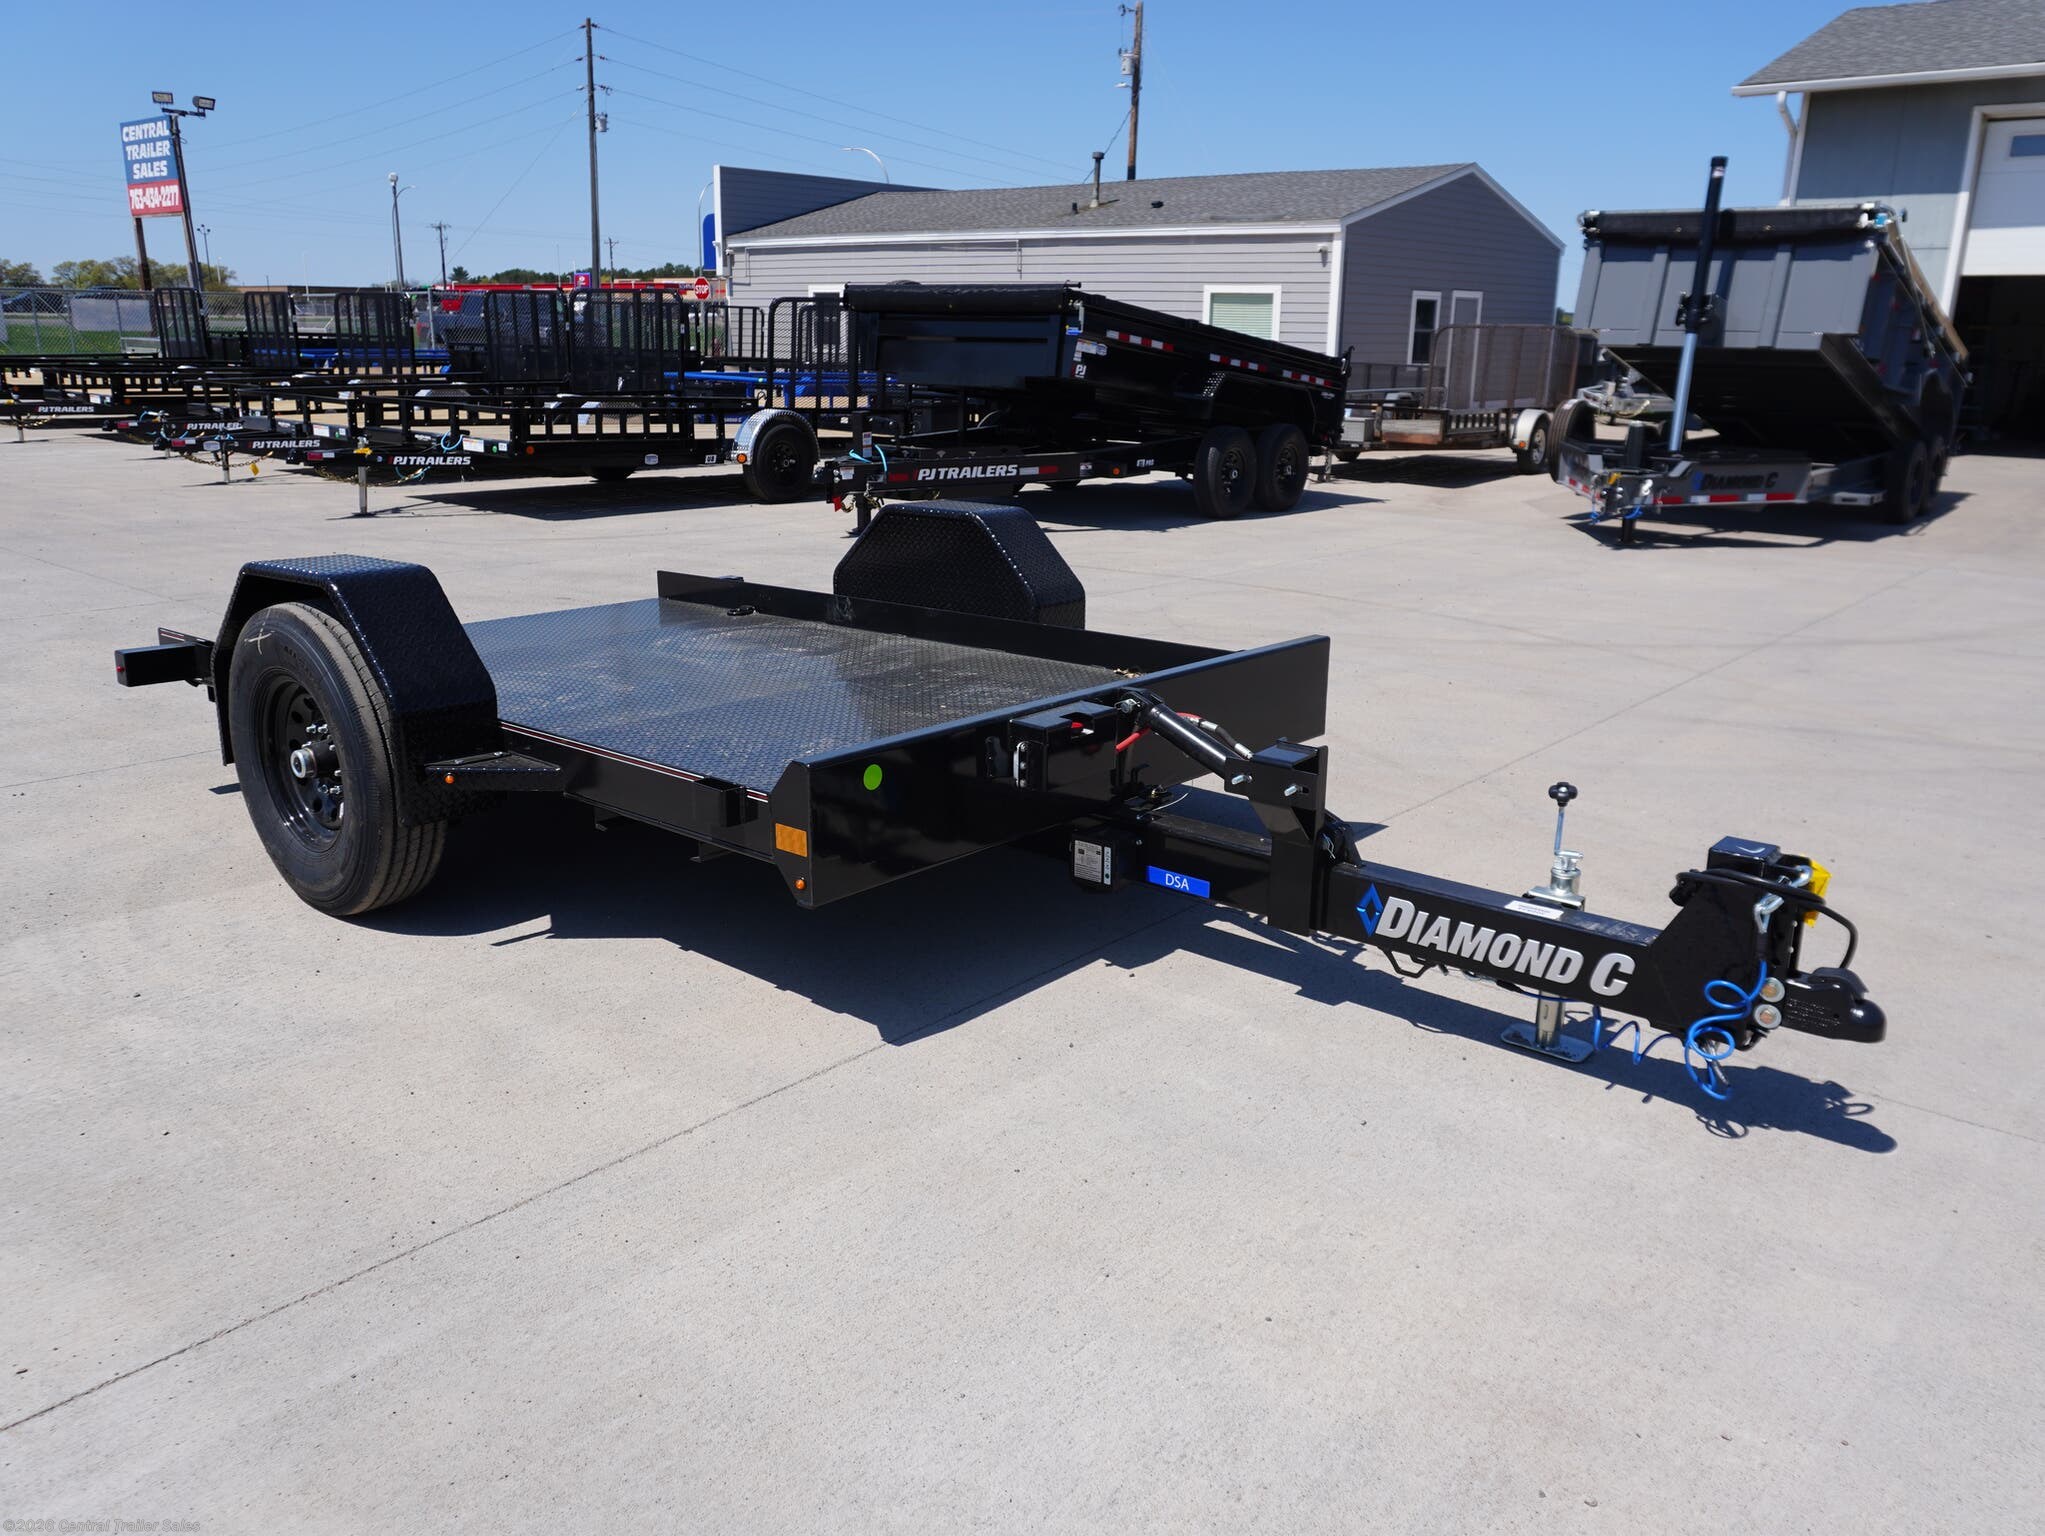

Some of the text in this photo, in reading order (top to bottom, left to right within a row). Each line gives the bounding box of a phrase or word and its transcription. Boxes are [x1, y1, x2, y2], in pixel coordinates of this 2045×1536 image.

[122, 120, 170, 142] CENTRAL
[126, 140, 170, 160] TRAILER
[133, 160, 168, 179] SALES
[129, 185, 179, 210] 763-434-2277
[695, 284, 710, 294] STOP
[266, 440, 321, 448] TRAILERS
[408, 456, 471, 465] TRAILERS
[938, 464, 1018, 480] TRAILERS
[1165, 873, 1189, 891] DSA
[1375, 896, 1636, 997] DIAMOND C
